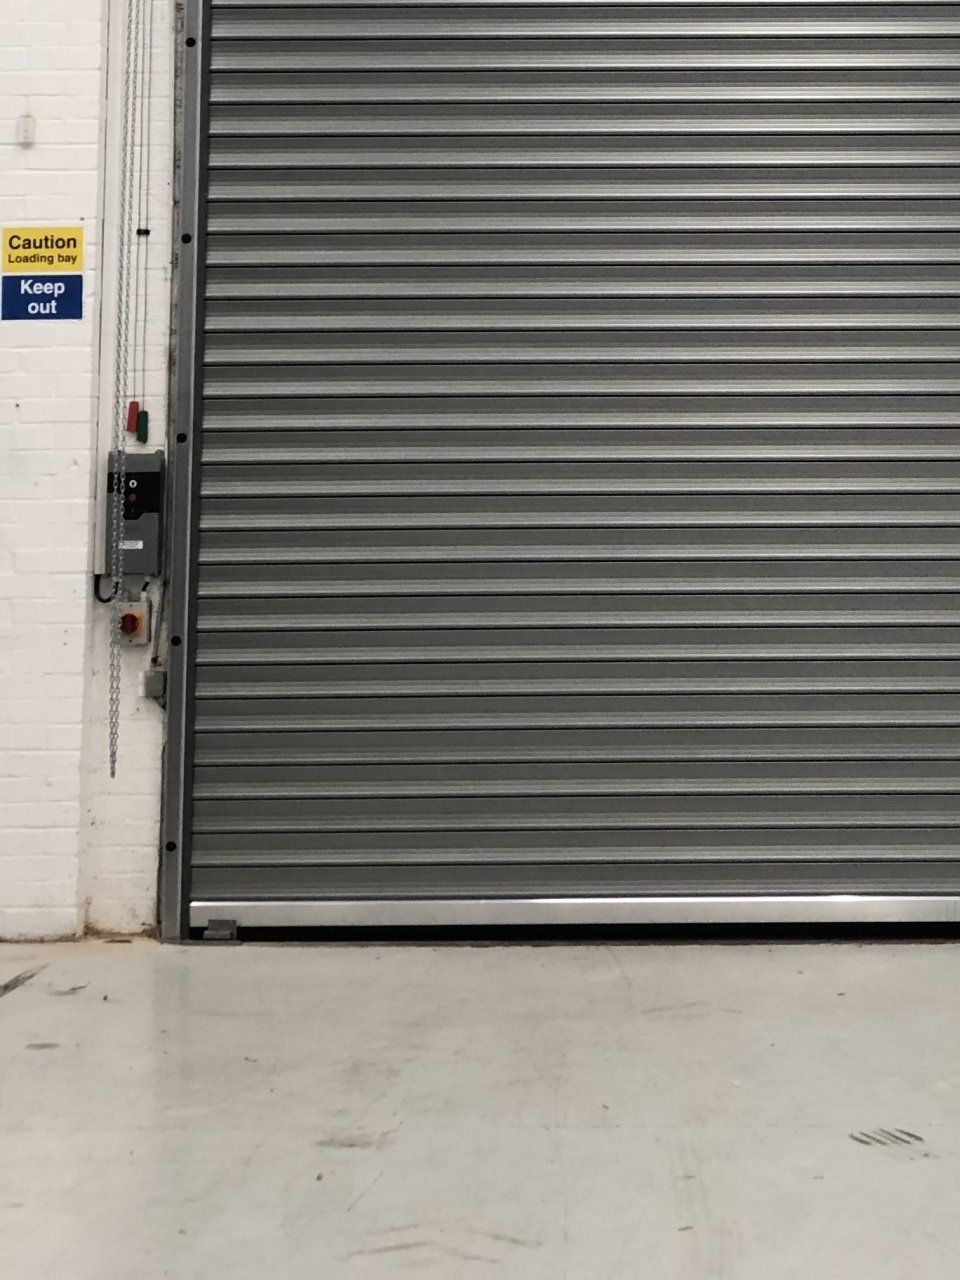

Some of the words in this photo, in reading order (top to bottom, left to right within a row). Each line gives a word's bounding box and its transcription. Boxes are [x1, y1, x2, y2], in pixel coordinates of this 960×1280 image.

[8, 234, 77, 250] Caution
[8, 254, 54, 265] Loading
[57, 253, 78, 265] bay
[20, 279, 65, 298] Keep
[27, 300, 57, 314] out
